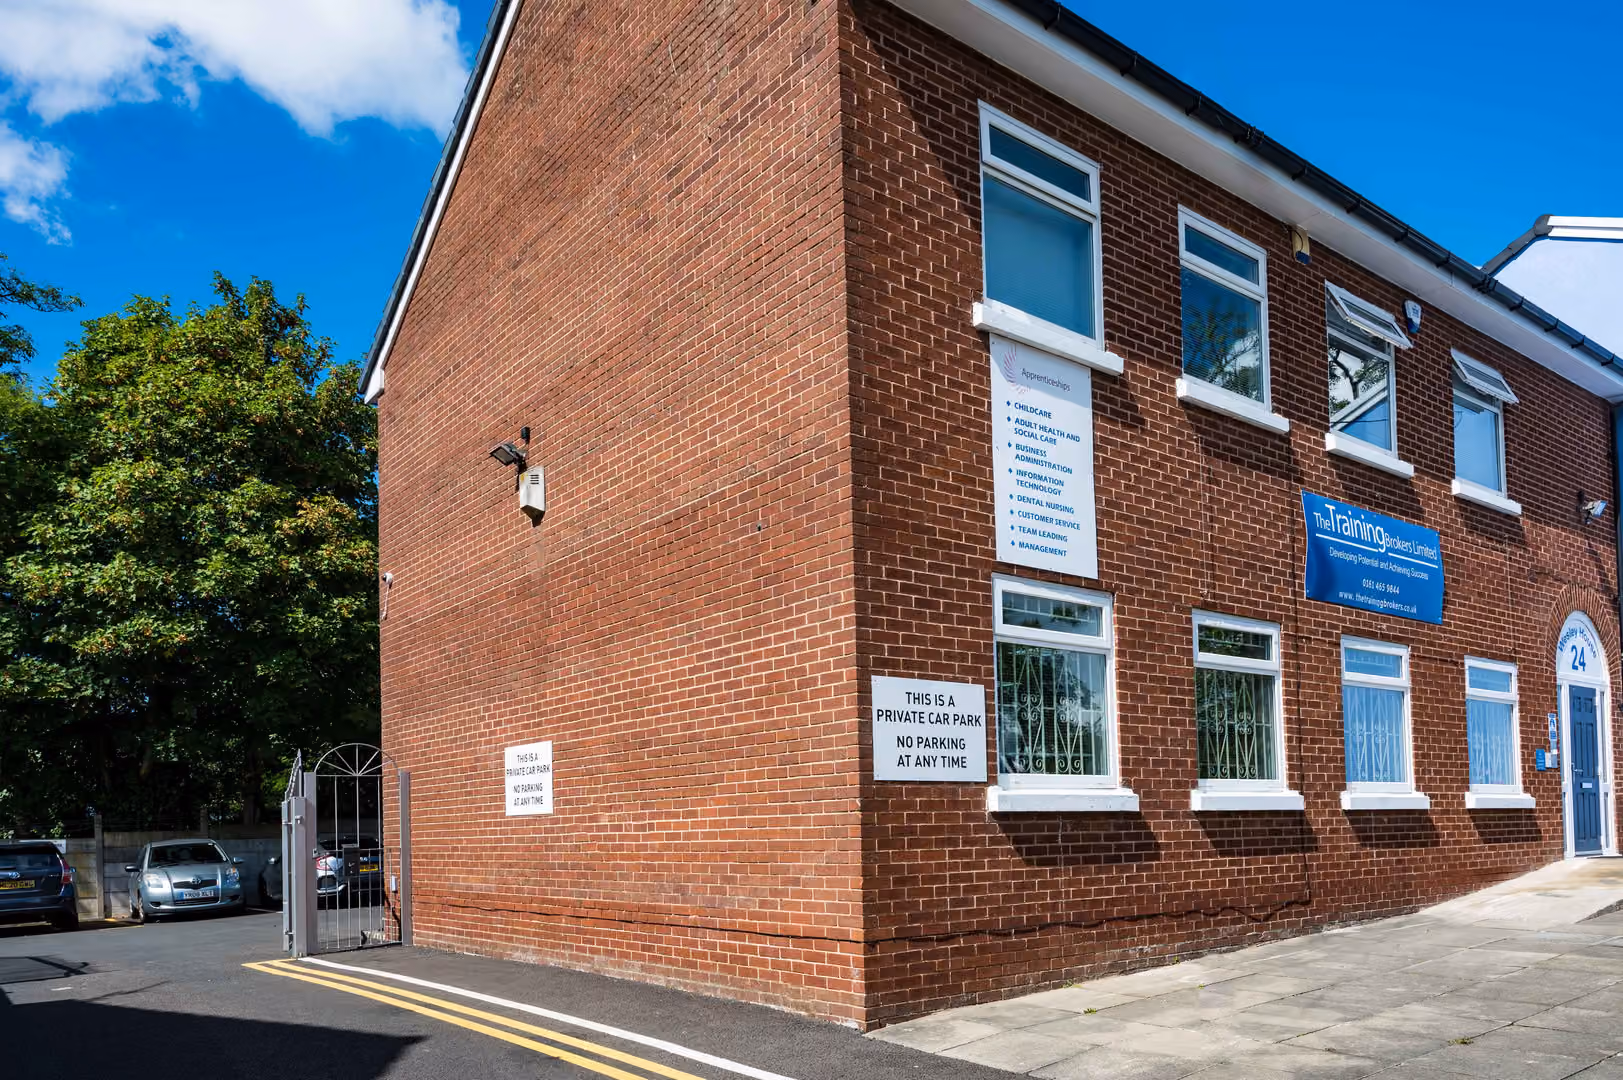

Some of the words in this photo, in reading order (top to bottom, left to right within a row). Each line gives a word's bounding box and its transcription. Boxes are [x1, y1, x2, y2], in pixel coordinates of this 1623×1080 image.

[1021, 368, 1071, 392] Apprenticeships
[1014, 402, 1052, 419] CHILDCARE
[1014, 417, 1038, 430] ADULT
[1039, 423, 1065, 438] HEALTH
[1066, 433, 1080, 442] AND
[1014, 427, 1039, 440] SOCIAL
[1040, 435, 1057, 445] CARE
[1015, 443, 1047, 457] BUSINESS
[1015, 454, 1073, 474] ADMINISTRATION
[1016, 469, 1064, 487] INFORMATION
[1016, 479, 1062, 496] TECHNOLOGY
[1017, 494, 1044, 507] DENTAL
[1045, 502, 1074, 514] NURSING
[1018, 510, 1053, 524] CUSTOMER
[1055, 519, 1081, 531] SERVICE
[1018, 525, 1037, 536] TEAM
[1039, 529, 1068, 542] LEADING
[1325, 503, 1386, 553] Training
[1385, 533, 1412, 553] Brokers
[1412, 540, 1437, 560] Limited
[1019, 541, 1067, 557] MANAGEMENT
[1329, 547, 1357, 564] Developing
[1358, 554, 1379, 567] Potential
[1380, 561, 1389, 570] and
[1388, 562, 1411, 577] Achieving
[1410, 568, 1429, 580] Success
[1558, 627, 1578, 652] Wesley
[1571, 645, 1586, 672] 24
[905, 691, 932, 706] THIS
[935, 694, 945, 707] IS
[947, 695, 956, 707] A
[876, 709, 925, 724] PRIVATE
[928, 712, 950, 725] CAR
[953, 713, 982, 727] PARK
[896, 735, 913, 749] NO
[917, 736, 966, 750] PARKING
[517, 753, 528, 763] THIS
[529, 752, 534, 762] IS
[534, 752, 539, 762] A
[897, 754, 912, 768] AT
[914, 755, 938, 768] ANY
[941, 755, 967, 769] TIME
[506, 767, 525, 776] PRIVATE
[526, 766, 536, 775] CAR
[537, 764, 551, 774] PARK
[513, 784, 520, 793] NO
[521, 782, 543, 793] PARKING
[514, 797, 520, 806] AT
[520, 796, 530, 806] ANY
[532, 796, 543, 805] TIME
